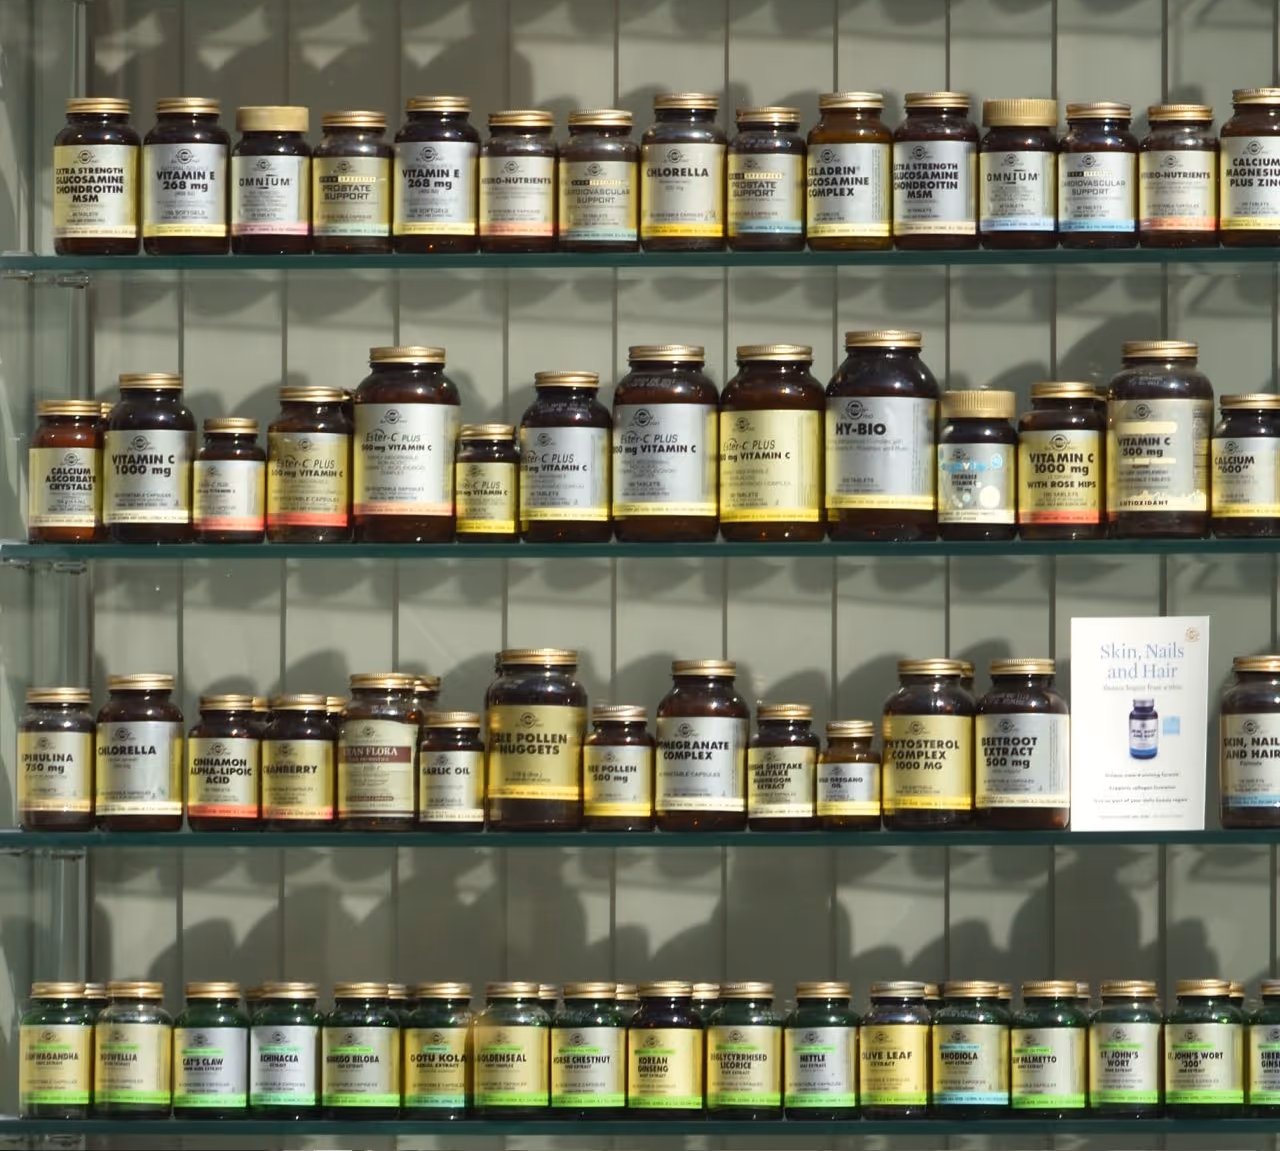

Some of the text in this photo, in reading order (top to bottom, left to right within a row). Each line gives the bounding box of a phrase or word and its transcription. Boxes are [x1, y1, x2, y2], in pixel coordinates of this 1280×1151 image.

[1233, 158, 1280, 168] CALCIUM
[156, 171, 205, 180] VITAMIN
[402, 169, 450, 178] VITAMIN
[646, 168, 709, 177] CHLORELLA
[163, 181, 185, 191] 268
[408, 179, 431, 188] 268
[72, 194, 99, 204] MSM
[835, 422, 887, 435] HY-BIO
[388, 444, 427, 452] VITAMIN
[111, 454, 164, 465] VITAMIN
[1029, 453, 1085, 463] VITAMIN
[51, 467, 91, 475] CALCIUM
[115, 464, 147, 475] 1000
[1034, 463, 1067, 473] 1000
[1050, 480, 1097, 489] ROSE HIPS
[1101, 642, 1184, 661] Skin, Nails
[1108, 662, 1178, 679] and Hair
[517, 733, 568, 744] POLLEN
[981, 737, 1038, 747] BEETROOT
[366, 747, 398, 757] FLORA
[500, 744, 560, 755] NUGGETS
[984, 748, 1034, 758] EXTRACT
[664, 751, 713, 761] COMPLEX
[924, 761, 942, 770] MG
[985, 758, 1007, 768] 500
[455, 767, 471, 776] OIL
[206, 776, 231, 785] ACID
[886, 1051, 913, 1060] LEAF
[1200, 1051, 1224, 1060] WORT
[1107, 1059, 1131, 1068] WORT
